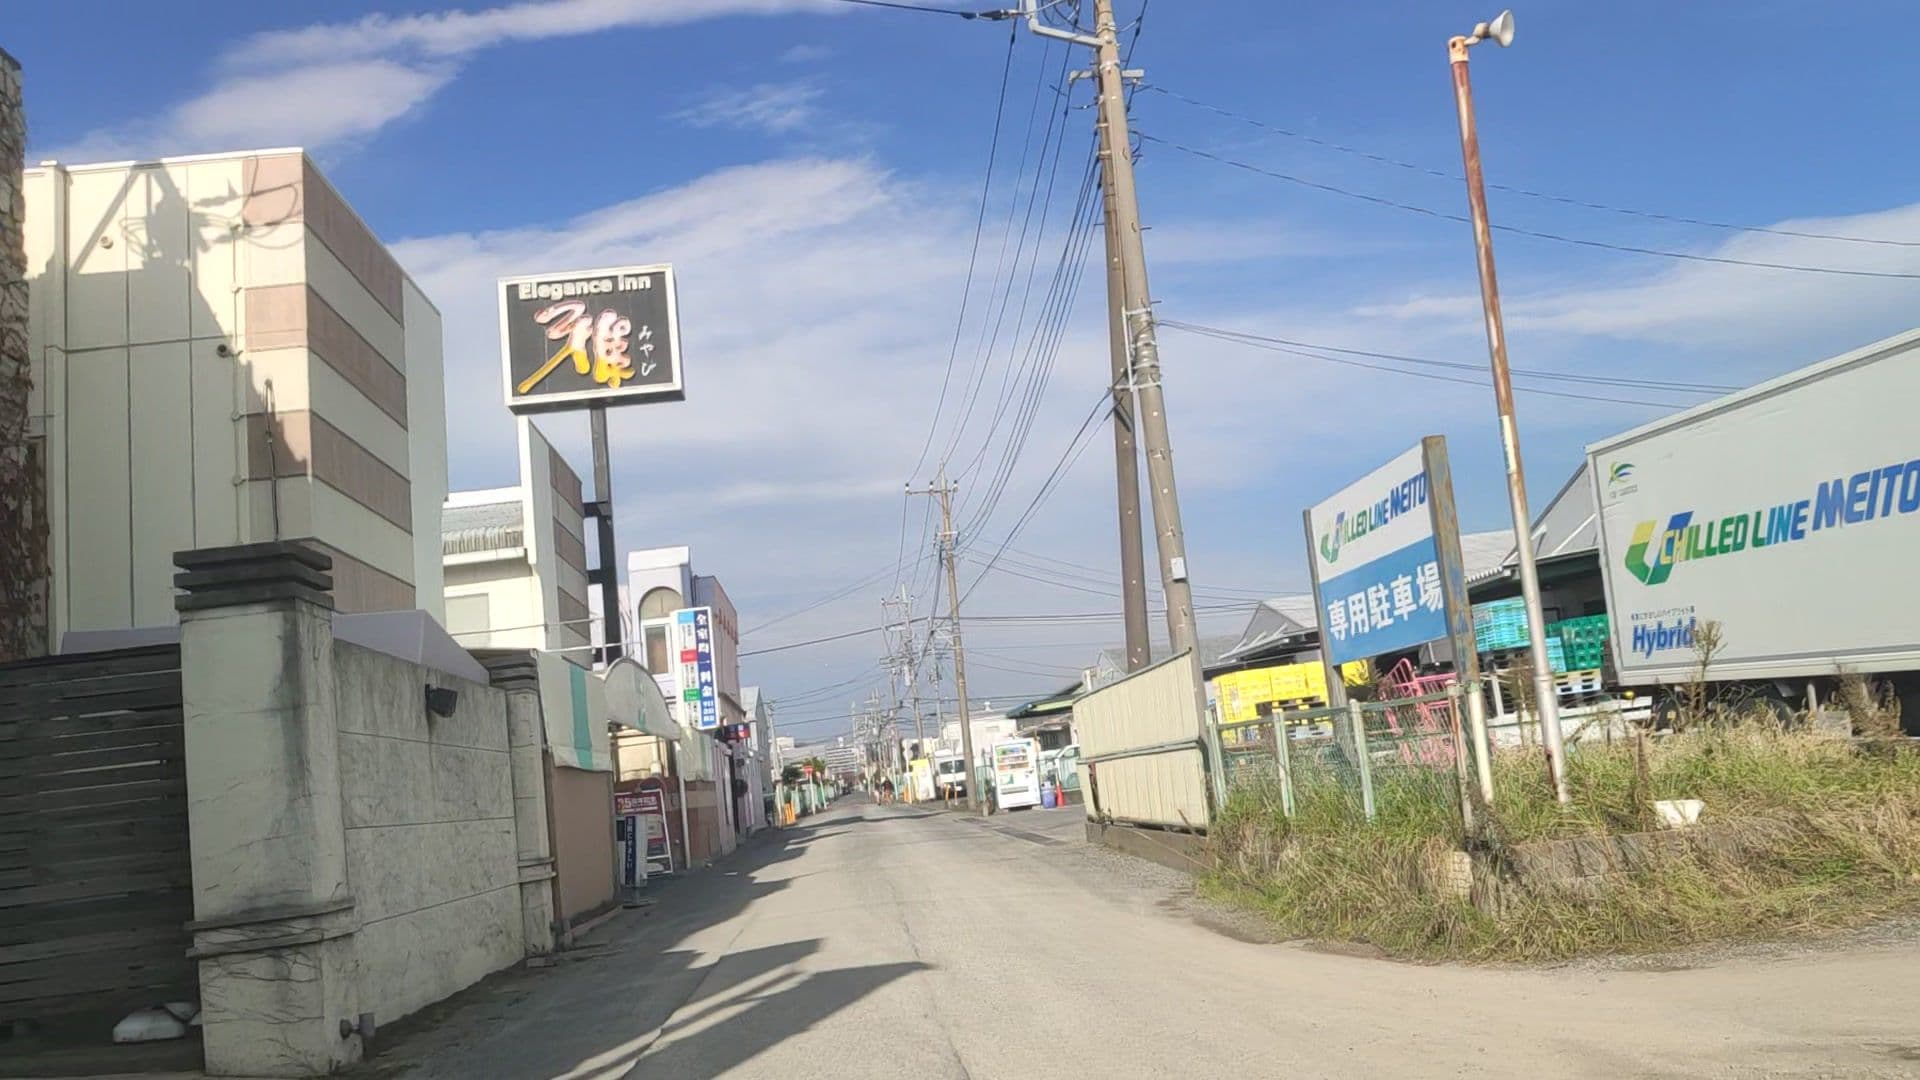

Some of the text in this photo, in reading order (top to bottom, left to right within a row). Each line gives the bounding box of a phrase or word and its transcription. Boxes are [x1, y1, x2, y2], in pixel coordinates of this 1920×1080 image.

[518, 274, 652, 301] Elegance Inn
[517, 300, 636, 394] 雅
[638, 325, 657, 377] みやび
[1369, 498, 1389, 532] LINE
[1390, 469, 1427, 520] MEITO
[1660, 459, 1920, 565] CHILLED LINE MEITO
[1327, 560, 1443, 641] 専用駐車場
[1632, 616, 1697, 659] Hybrid
